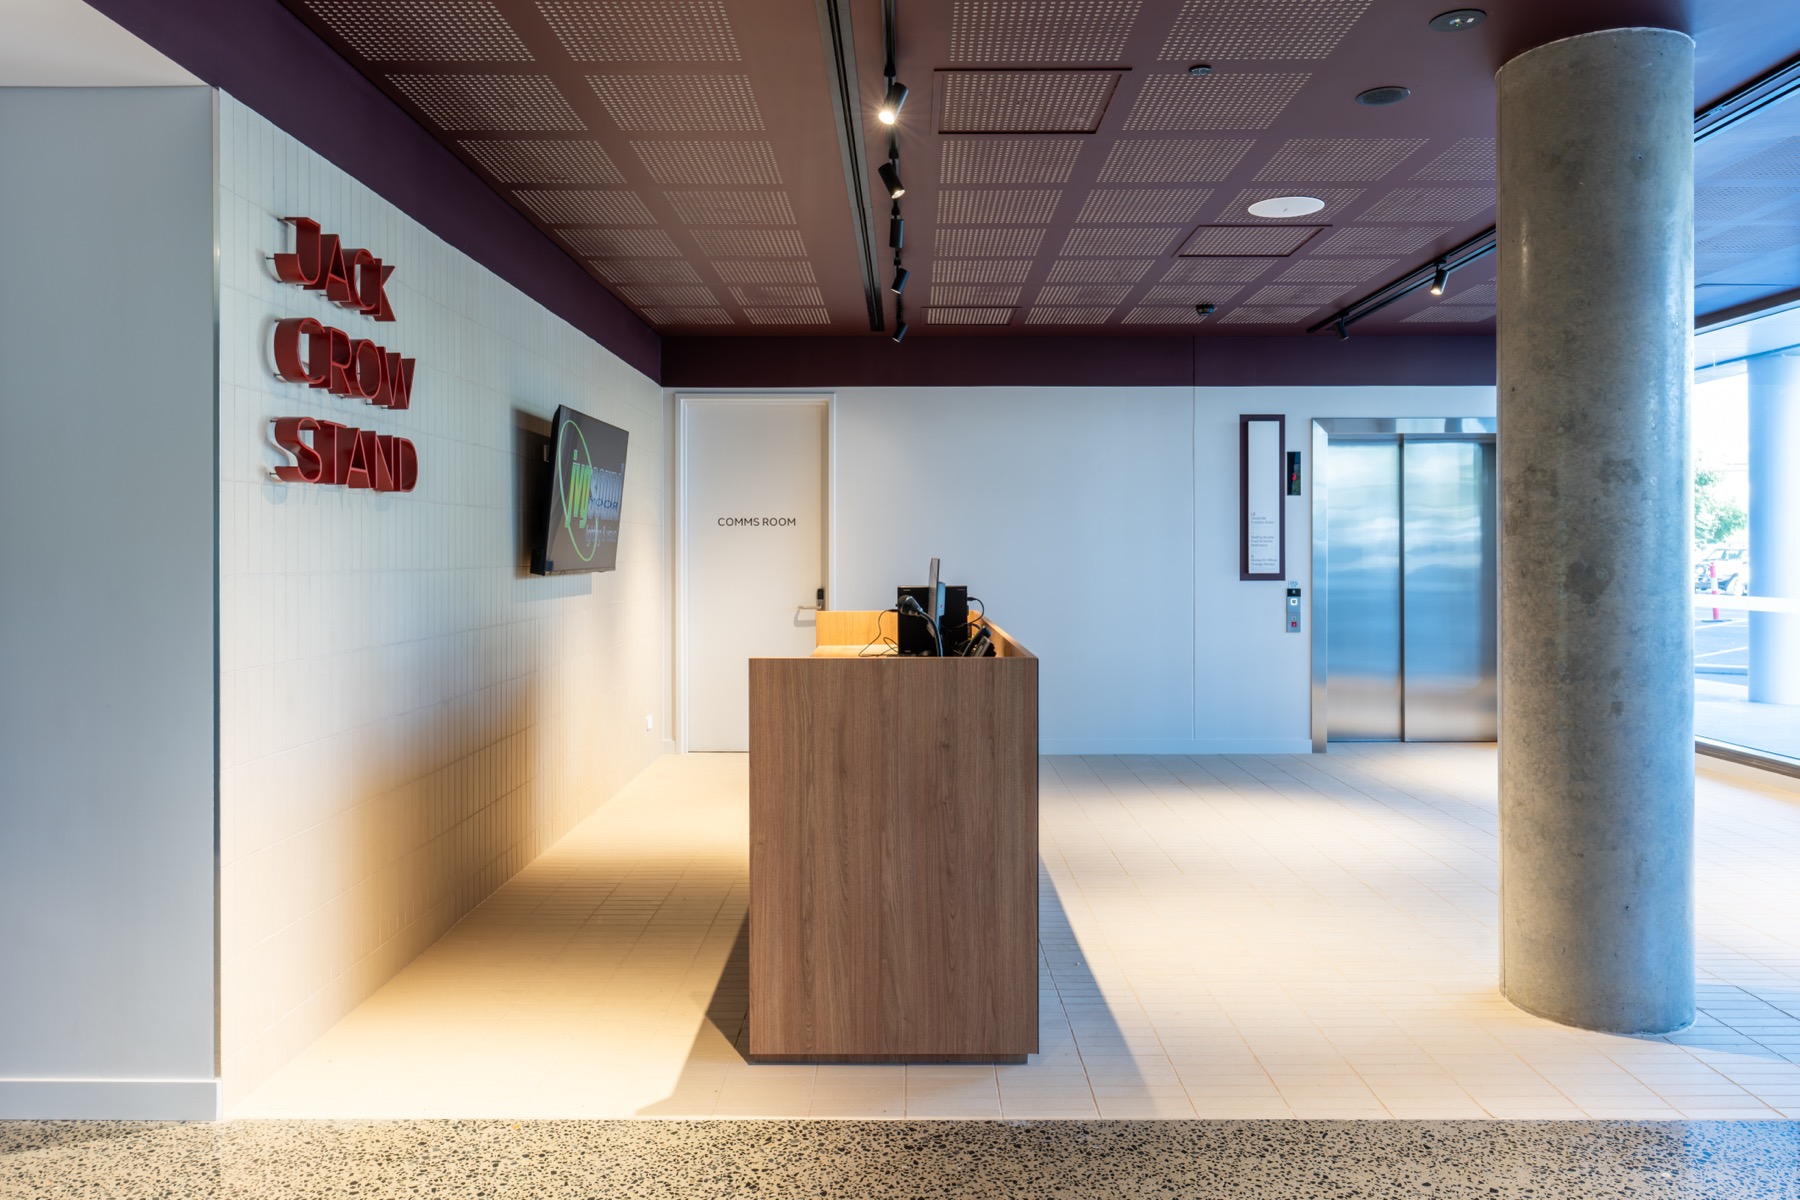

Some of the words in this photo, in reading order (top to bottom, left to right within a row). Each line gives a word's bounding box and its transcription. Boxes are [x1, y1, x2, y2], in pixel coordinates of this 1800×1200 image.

[273, 216, 396, 322] JACK
[273, 317, 416, 410] CROW
[274, 416, 418, 493] STAND
[717, 517, 760, 527] COMMS
[762, 517, 796, 527] ROOM
